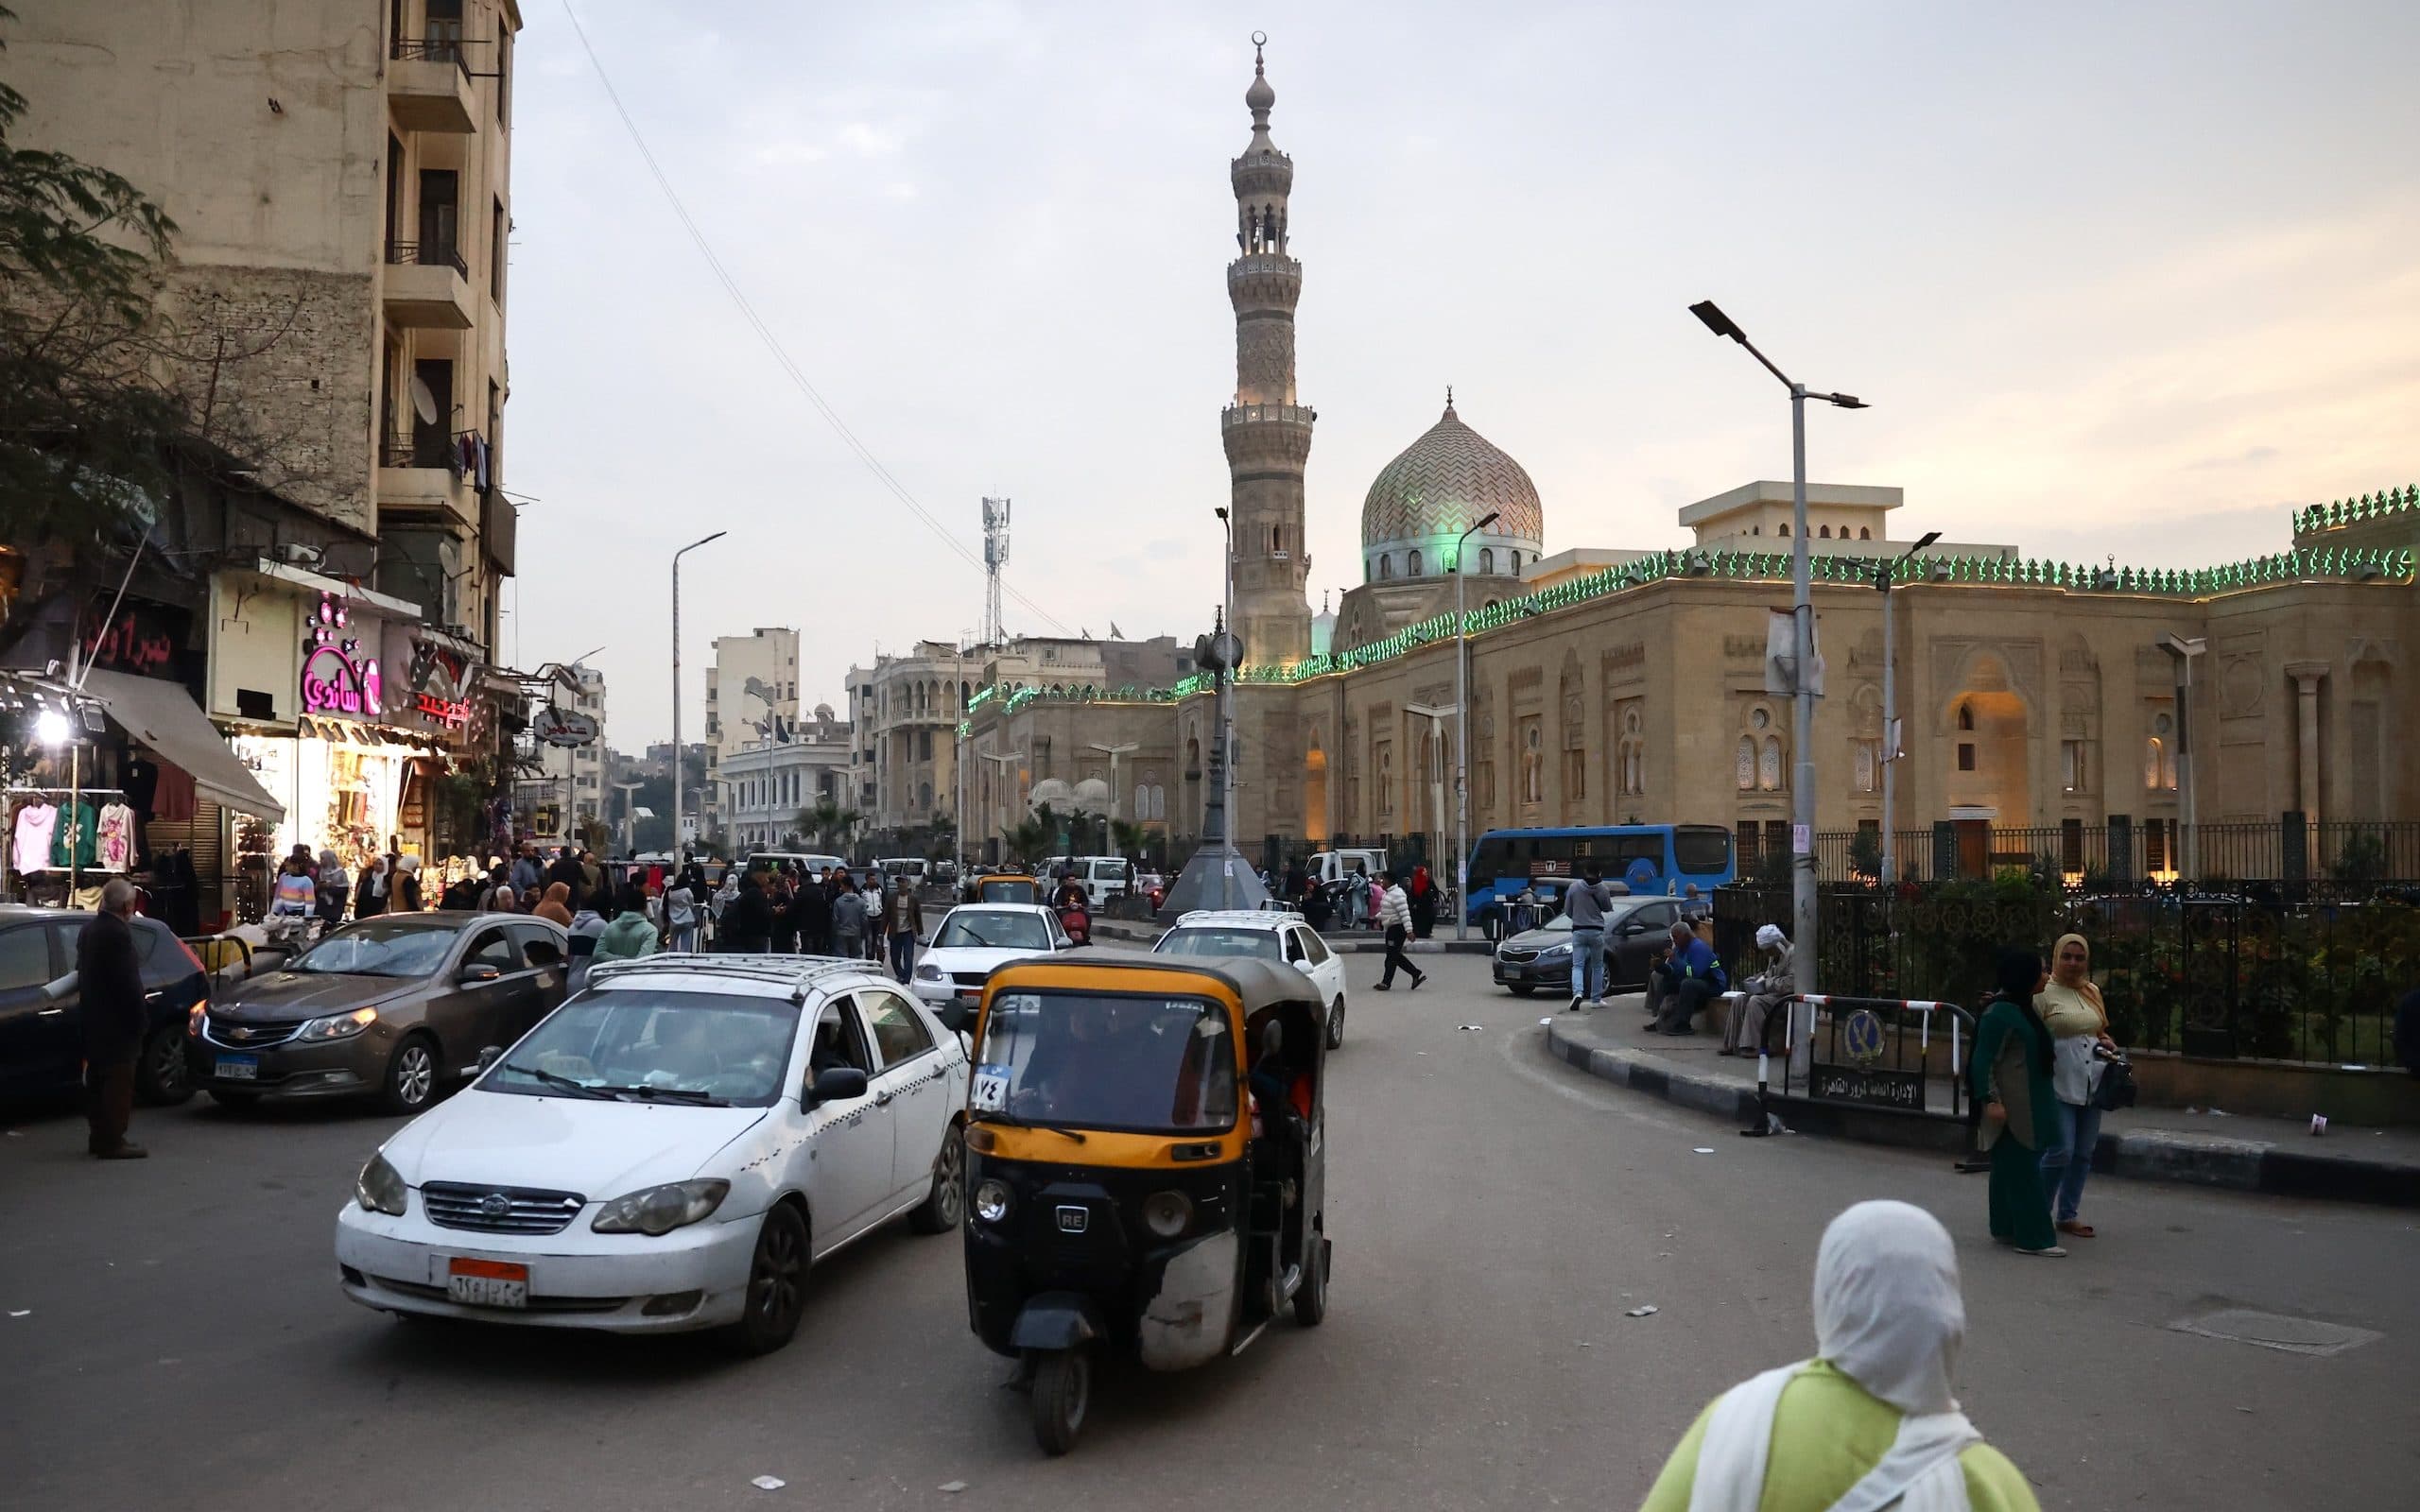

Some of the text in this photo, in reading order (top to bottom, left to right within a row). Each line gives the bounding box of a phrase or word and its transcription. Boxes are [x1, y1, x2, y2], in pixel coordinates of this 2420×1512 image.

[303, 665, 361, 713] ساندي
[1821, 1075, 1848, 1096] القاهرة
[1891, 1081, 1918, 1105] الإدارة
[1063, 1215, 1082, 1228] RE
